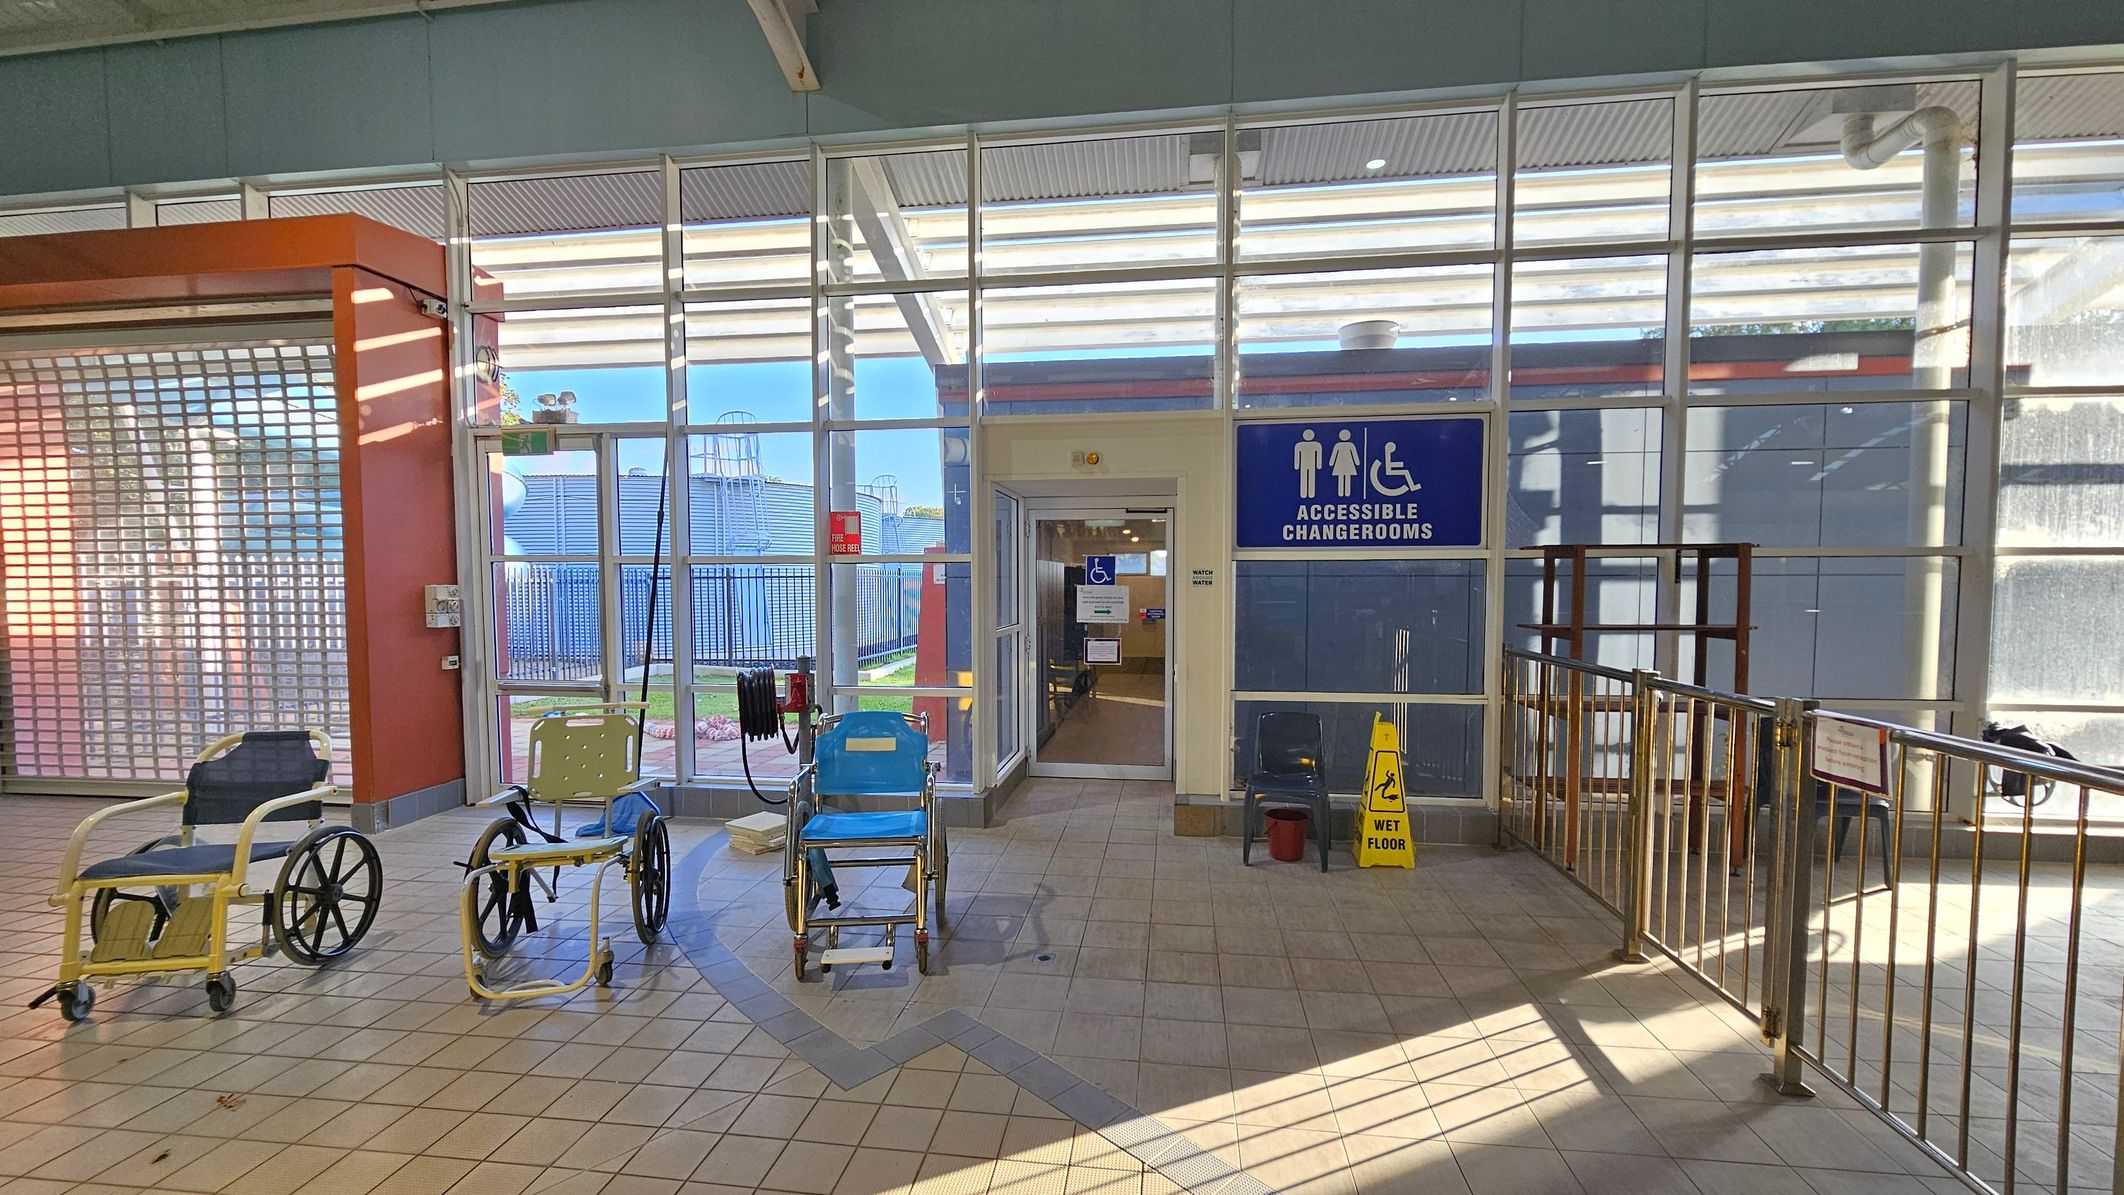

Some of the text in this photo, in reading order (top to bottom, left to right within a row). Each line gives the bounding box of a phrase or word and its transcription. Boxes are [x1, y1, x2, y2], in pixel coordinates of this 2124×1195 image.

[1296, 503, 1418, 521] ACCESSIBLE
[831, 533, 844, 542] FIRE
[1282, 522, 1433, 541] CHANGEROOMS
[831, 543, 861, 553] HOSE REEL
[1374, 820, 1400, 831] WET
[1367, 837, 1406, 850] FLOOR
